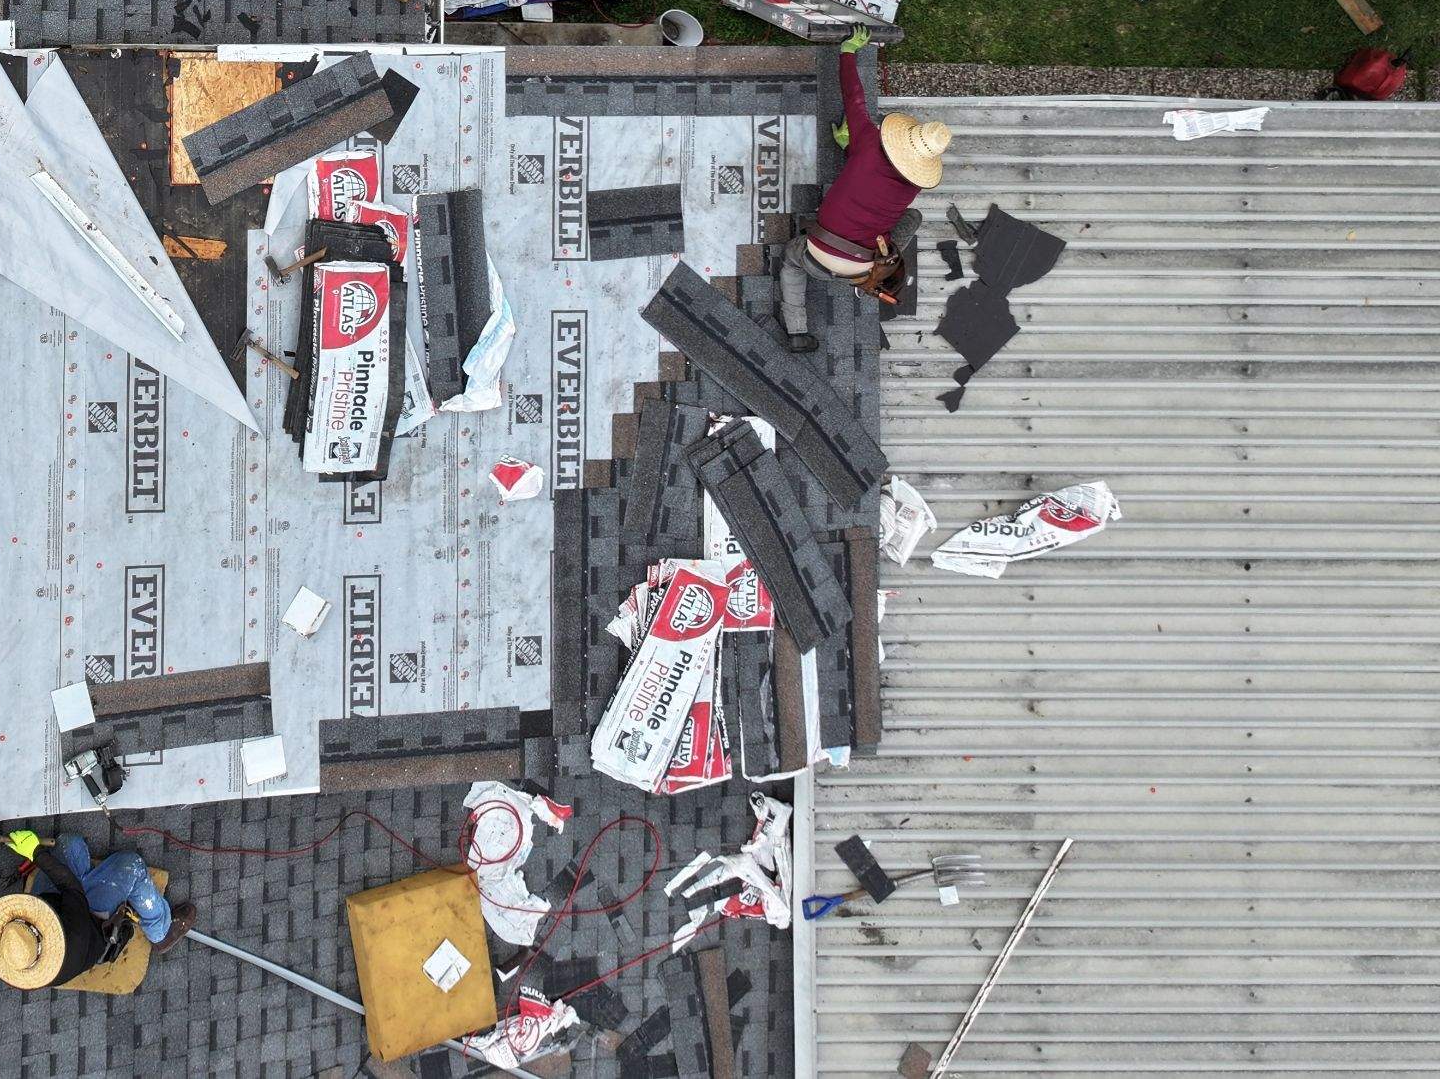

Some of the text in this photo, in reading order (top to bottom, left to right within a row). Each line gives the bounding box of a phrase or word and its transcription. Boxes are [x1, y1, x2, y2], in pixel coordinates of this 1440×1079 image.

[517, 155, 544, 184] HOME
[518, 167, 533, 184] DEPOT
[531, 158, 542, 170] THE
[558, 118, 582, 252] VERBILT
[333, 173, 346, 221] ATLAS
[310, 298, 321, 354] Pinnacle
[340, 286, 355, 335] ATLAS
[330, 371, 354, 431] Pristine
[349, 350, 375, 432] Pinnacle
[672, 588, 701, 632] ATLAS
[746, 570, 757, 613] ATLAS
[131, 574, 157, 678] EVER
[350, 585, 374, 709] ERBILT
[629, 661, 670, 722] Pristine
[646, 650, 694, 730] Pinnacle
